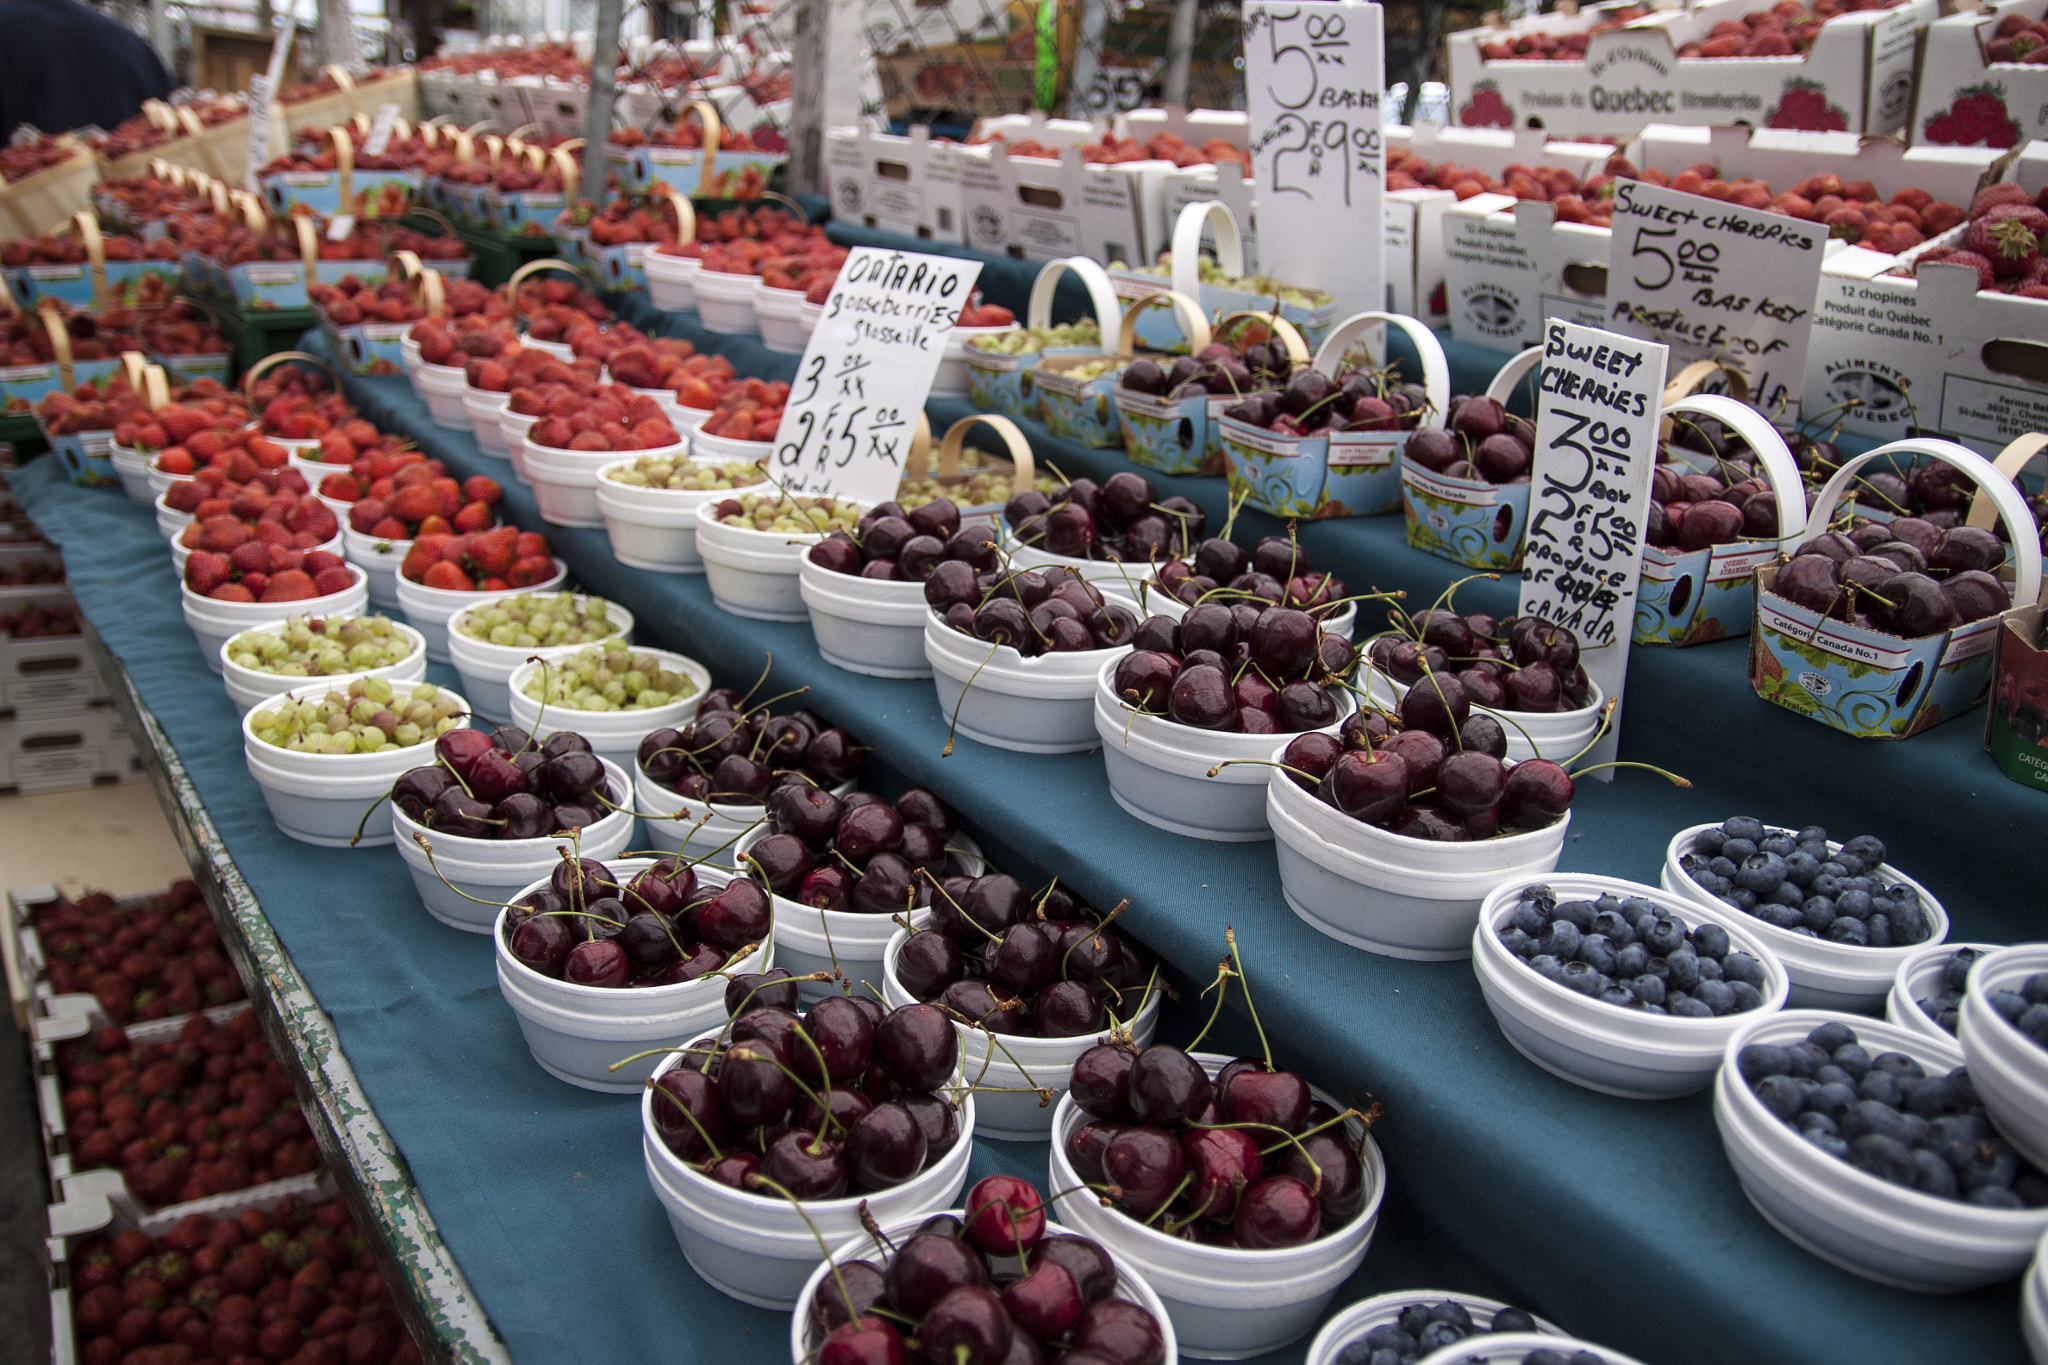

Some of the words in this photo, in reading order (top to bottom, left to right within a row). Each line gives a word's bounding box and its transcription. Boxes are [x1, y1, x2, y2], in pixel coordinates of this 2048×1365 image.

[1590, 84, 1676, 113] Quebec
[1841, 284, 1856, 298] 12
[1859, 287, 1917, 308] chopines
[1824, 300, 1866, 317] Produit
[1868, 306, 1884, 320] du
[1886, 309, 1931, 329] Québec
[1867, 322, 1910, 341] Canada
[1913, 329, 1934, 345] No.
[1937, 334, 1944, 346] 1
[1546, 325, 1643, 378] SWEET
[2000, 395, 2031, 409] Ferme
[1522, 567, 1554, 583] OF
[1773, 617, 1815, 640] Catégori
[1817, 635, 1853, 654] Canada
[1855, 646, 1879, 661] No.1
